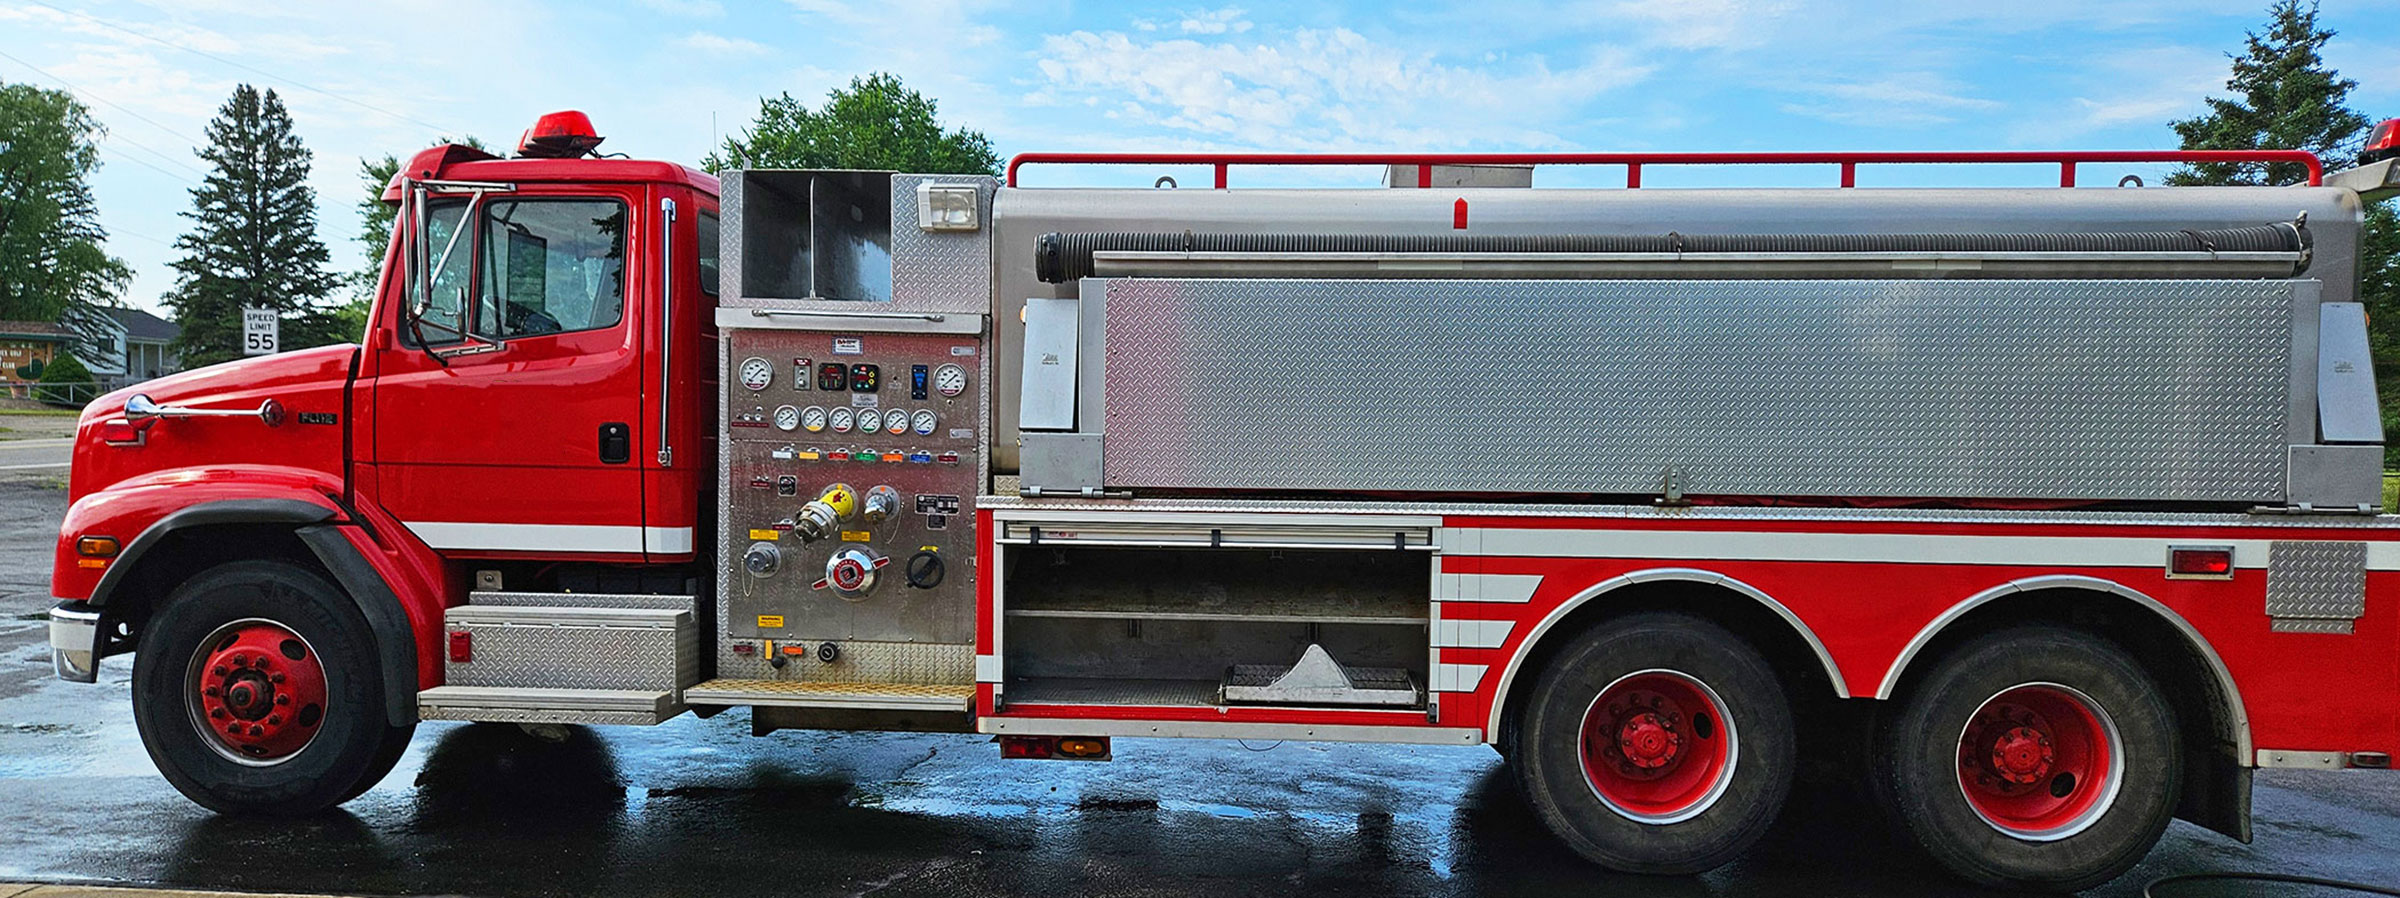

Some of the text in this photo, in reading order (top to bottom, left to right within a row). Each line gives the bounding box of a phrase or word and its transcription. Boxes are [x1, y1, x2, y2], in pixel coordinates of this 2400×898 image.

[247, 313, 275, 322] SPEED
[249, 323, 271, 331] LIMIT
[248, 333, 274, 350] 55
